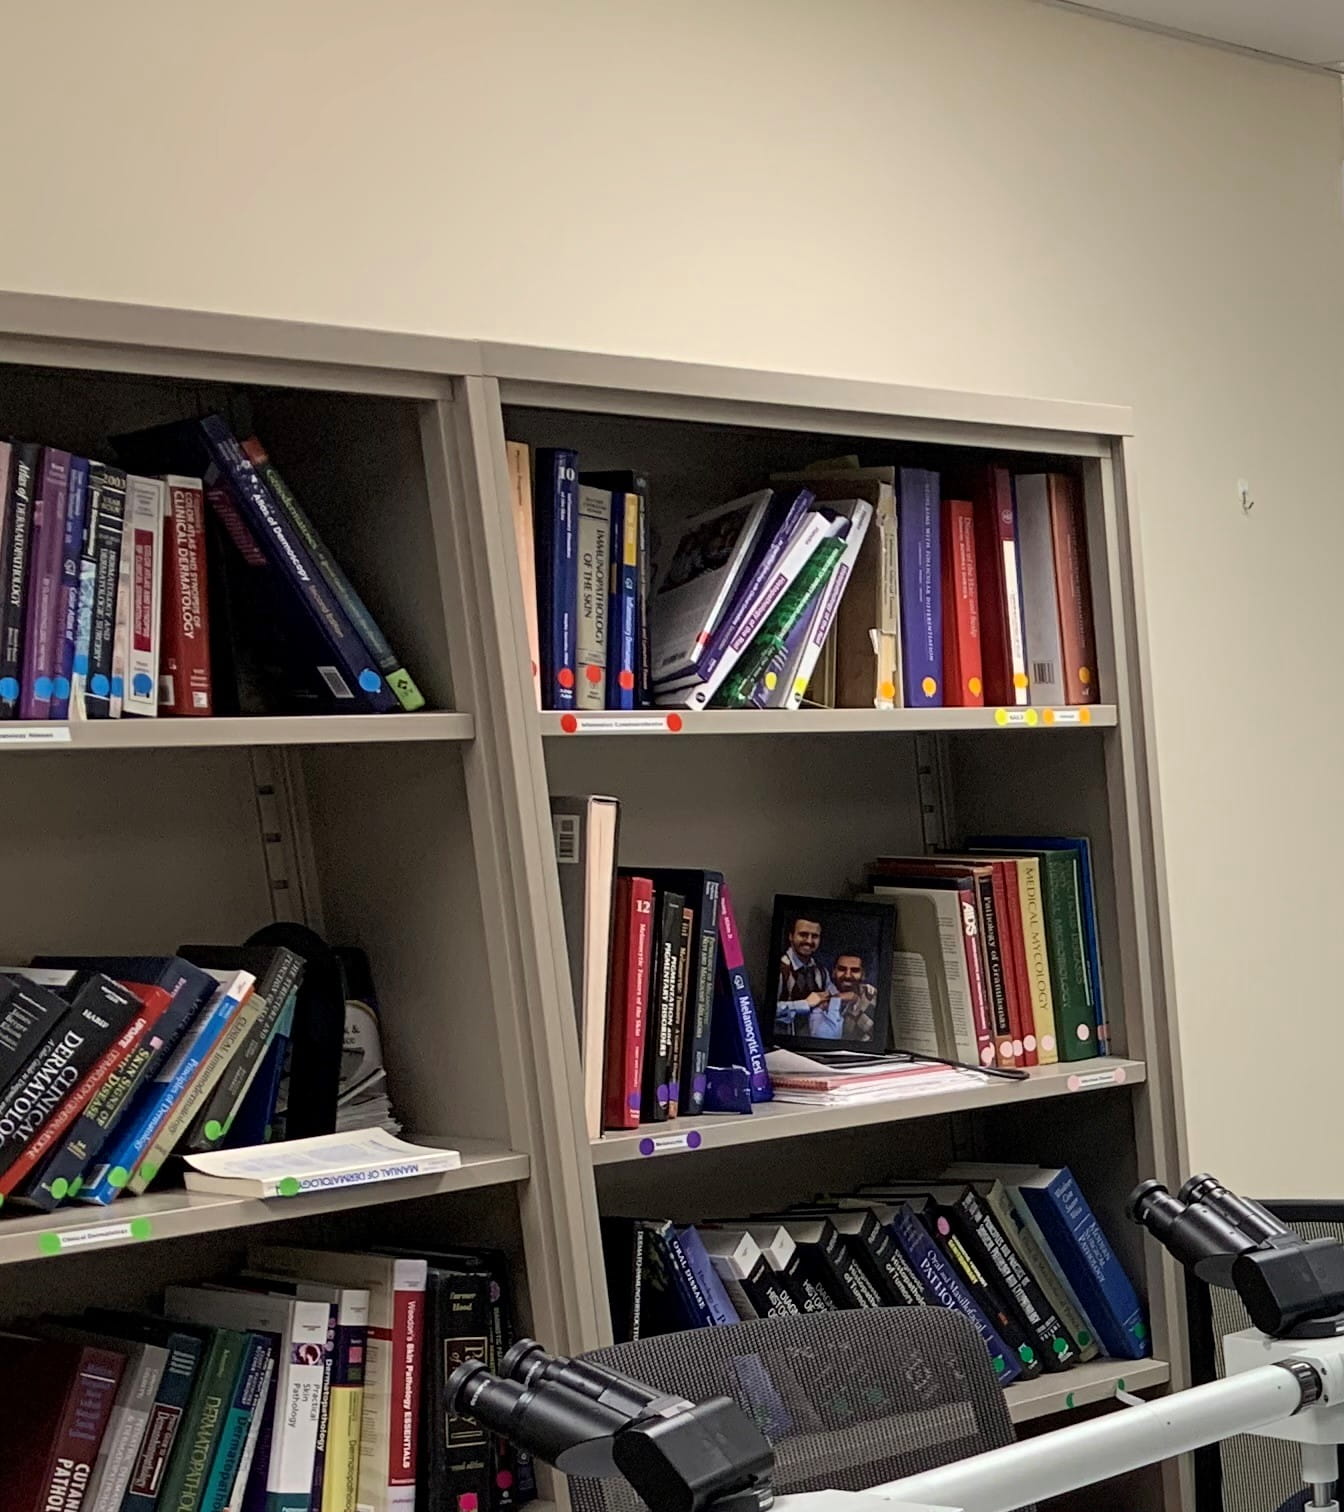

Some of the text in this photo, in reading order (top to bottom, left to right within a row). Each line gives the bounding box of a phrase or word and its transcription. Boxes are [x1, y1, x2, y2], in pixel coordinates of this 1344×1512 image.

[18, 461, 31, 487] Atlas
[559, 466, 575, 481] 10
[10, 502, 27, 607] DERMATOPATHOLOGY
[252, 494, 311, 582] Atlas of Dermoscopy
[174, 490, 194, 639] CLINICAL DERMATOLOGY
[584, 570, 592, 591] THE
[595, 529, 605, 646] IMMUNOPATHOLOGY
[636, 900, 650, 913] 12
[962, 901, 977, 937] AIDS
[1025, 867, 1048, 1011] MEDICAL MYCOLOGY
[117, 1017, 147, 1049] UPDATE
[740, 995, 758, 1053] Melanocytic
[126, 1048, 151, 1078] SKIN
[173, 1058, 199, 1096] Principles
[0, 1029, 84, 1149] DERMATOLO
[12, 1065, 79, 1142] CLINICAL
[104, 1075, 132, 1110] SIGNS
[134, 1102, 169, 1151] Dermatology
[300, 1164, 419, 1190] MANUAL OF DERMATOLOG
[673, 1240, 706, 1310] ORAL DISEASE
[889, 1254, 926, 1307] Histopatholo
[920, 1257, 957, 1311] PATHOL
[927, 1250, 943, 1271] Oral
[289, 1383, 302, 1428] Pathology
[302, 1383, 311, 1402] Skin
[311, 1383, 320, 1422] Practical
[316, 1358, 333, 1452] Dermatopathology
[402, 1300, 417, 1469] Weedon's Skin Pathology ESSENTIALS
